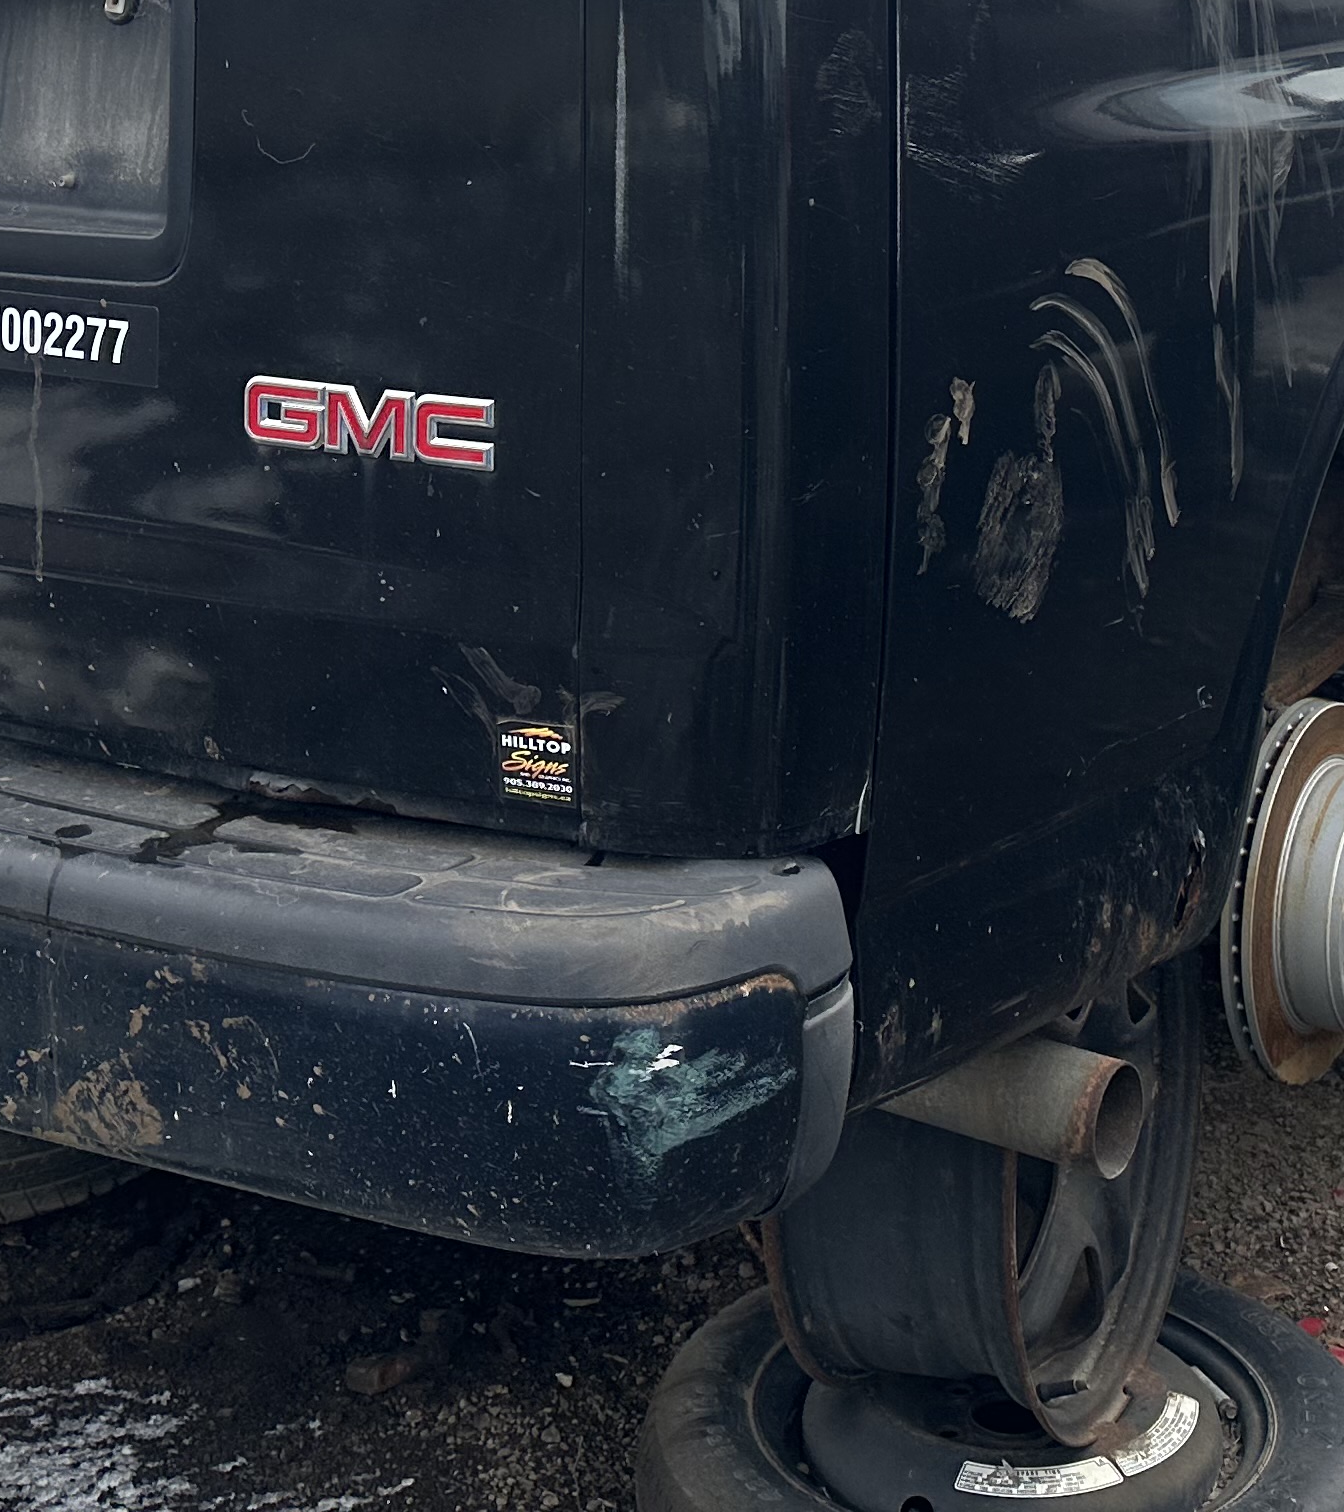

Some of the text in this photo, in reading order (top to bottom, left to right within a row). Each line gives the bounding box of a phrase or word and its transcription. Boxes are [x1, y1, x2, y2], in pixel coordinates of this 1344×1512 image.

[244, 374, 497, 473] GMC
[501, 734, 572, 755] HILLTOP
[501, 750, 570, 777] Signs
